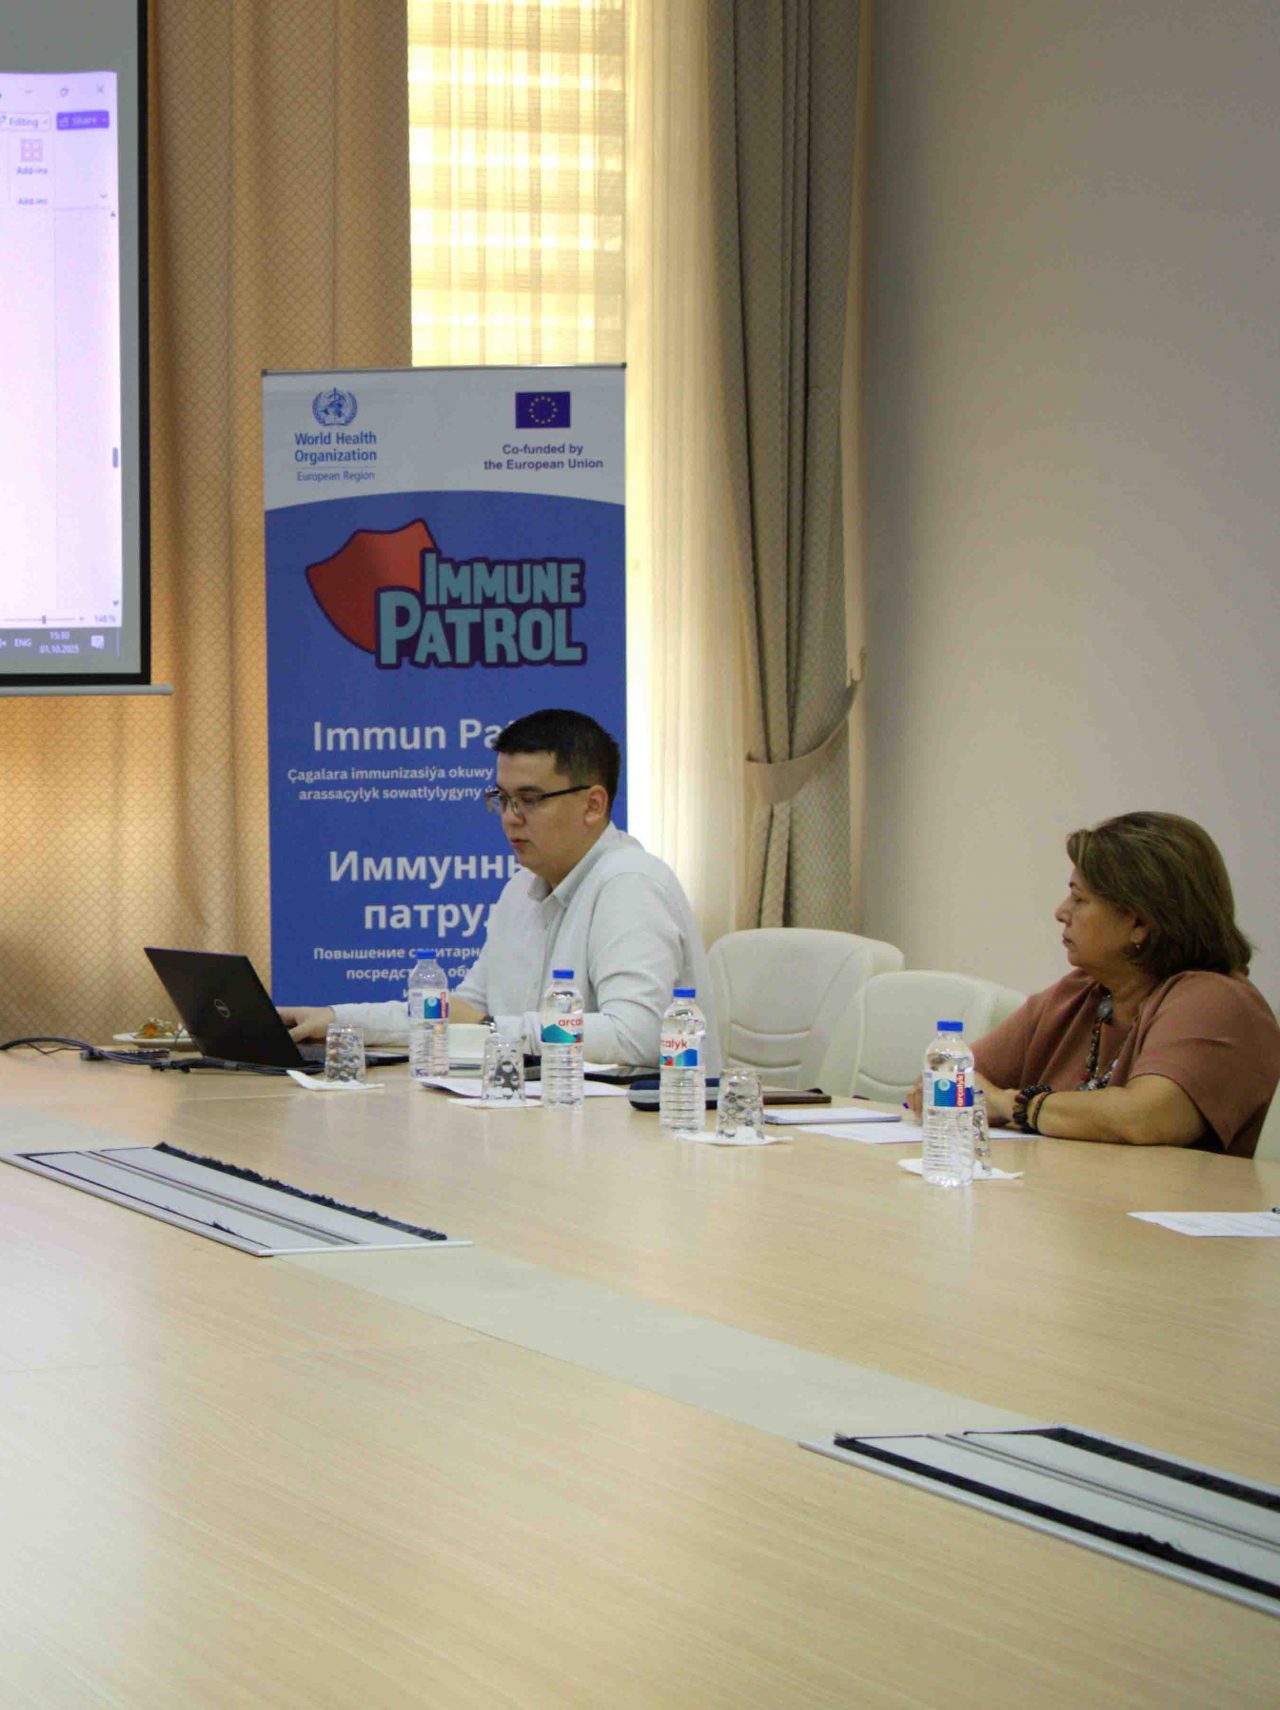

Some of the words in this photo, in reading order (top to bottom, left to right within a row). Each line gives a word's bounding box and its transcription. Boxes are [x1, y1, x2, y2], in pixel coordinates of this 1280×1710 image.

[9, 116, 39, 129] Editing
[294, 431, 332, 447] World
[336, 430, 377, 446] Health
[294, 448, 378, 466] Organization
[502, 443, 565, 456] Co-funded
[568, 443, 584, 458] by
[484, 458, 503, 471] the
[506, 458, 565, 473] European
[567, 457, 604, 471] Union
[296, 470, 341, 484] European
[343, 469, 376, 484] Region
[14, 638, 33, 648] ENG
[313, 720, 446, 752] Immun
[460, 718, 514, 750] Pa
[287, 767, 348, 785] Çagalara
[351, 766, 446, 784] immunizasiýa
[448, 766, 494, 781] okuwy
[298, 787, 380, 803] arassaçylyk
[364, 902, 497, 938] патру
[313, 946, 406, 961] Повышение
[408, 946, 480, 961] ситарн
[447, 964, 468, 978] об
